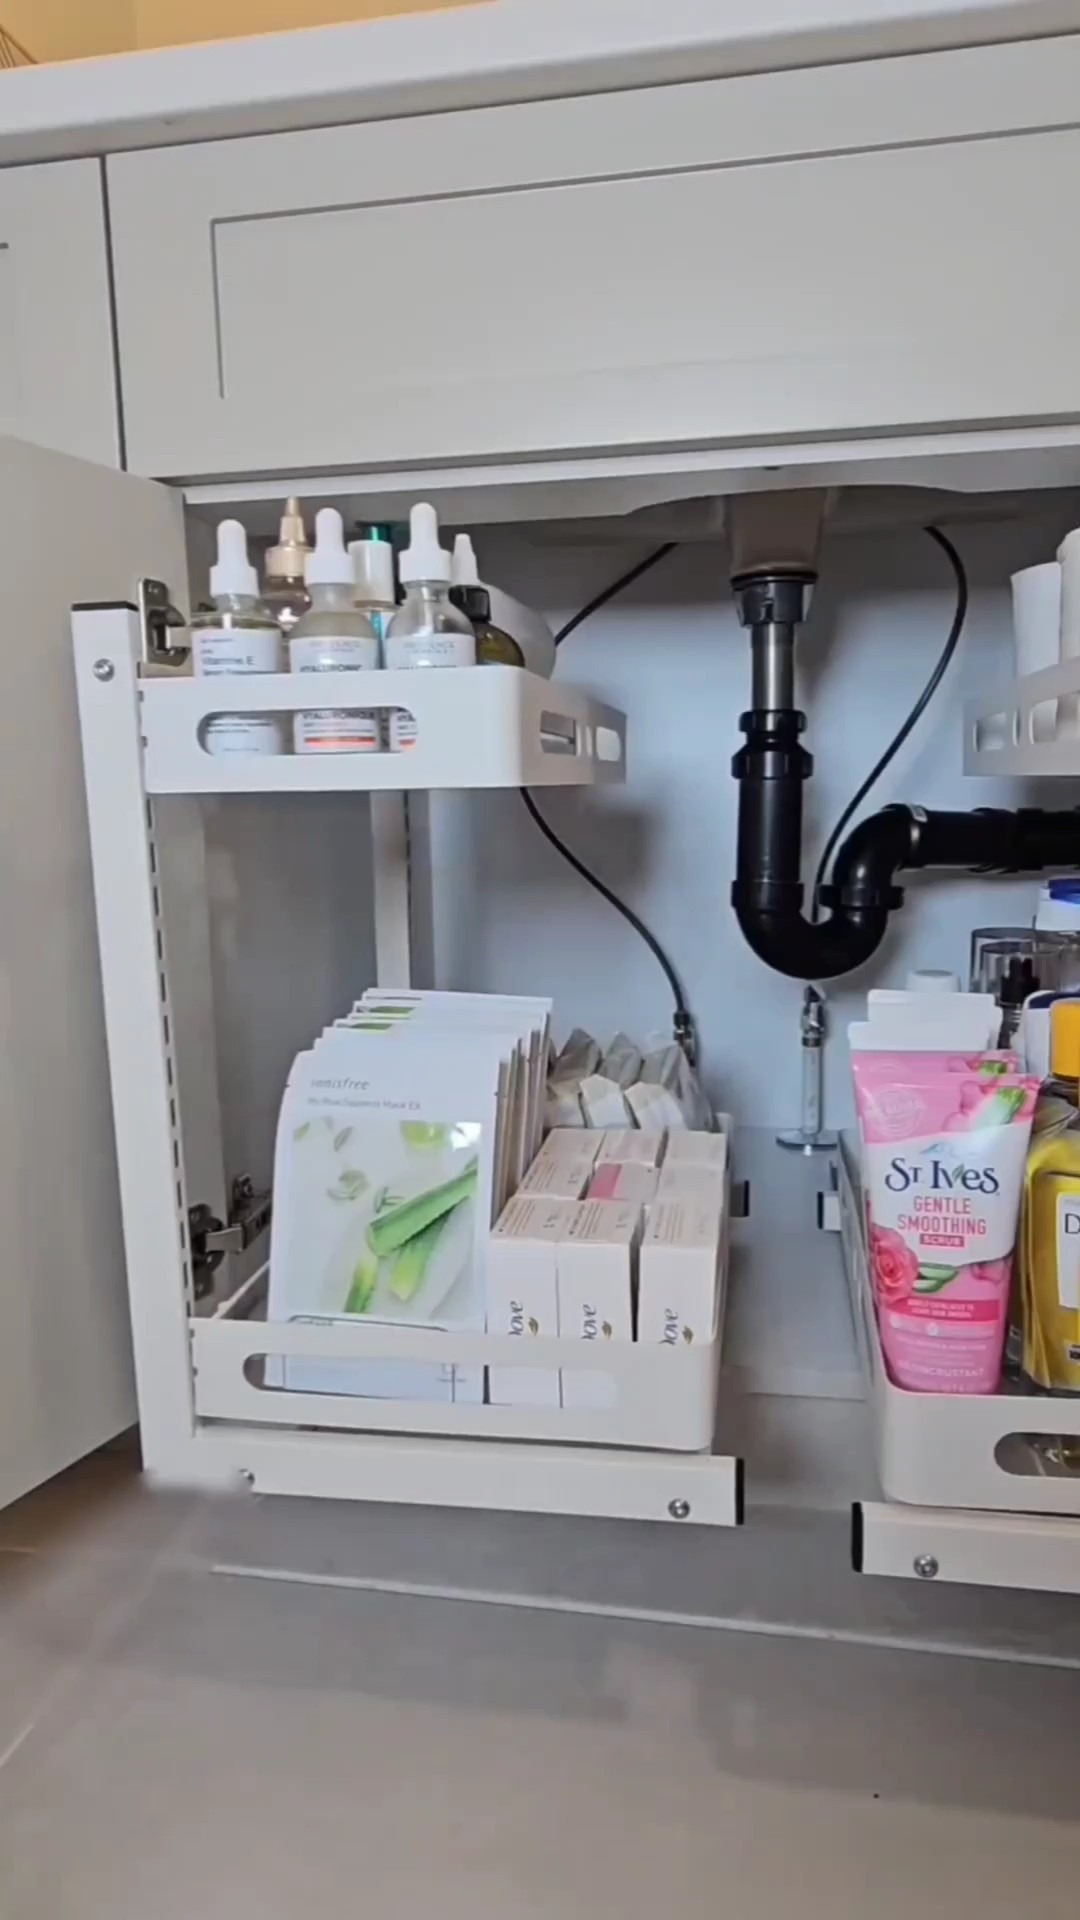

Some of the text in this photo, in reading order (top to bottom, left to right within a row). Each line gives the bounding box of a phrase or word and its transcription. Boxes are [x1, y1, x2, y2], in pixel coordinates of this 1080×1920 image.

[310, 1076, 370, 1091] innisfree
[913, 1196, 971, 1214] GENTLE
[897, 1214, 987, 1235] SMOOTHING
